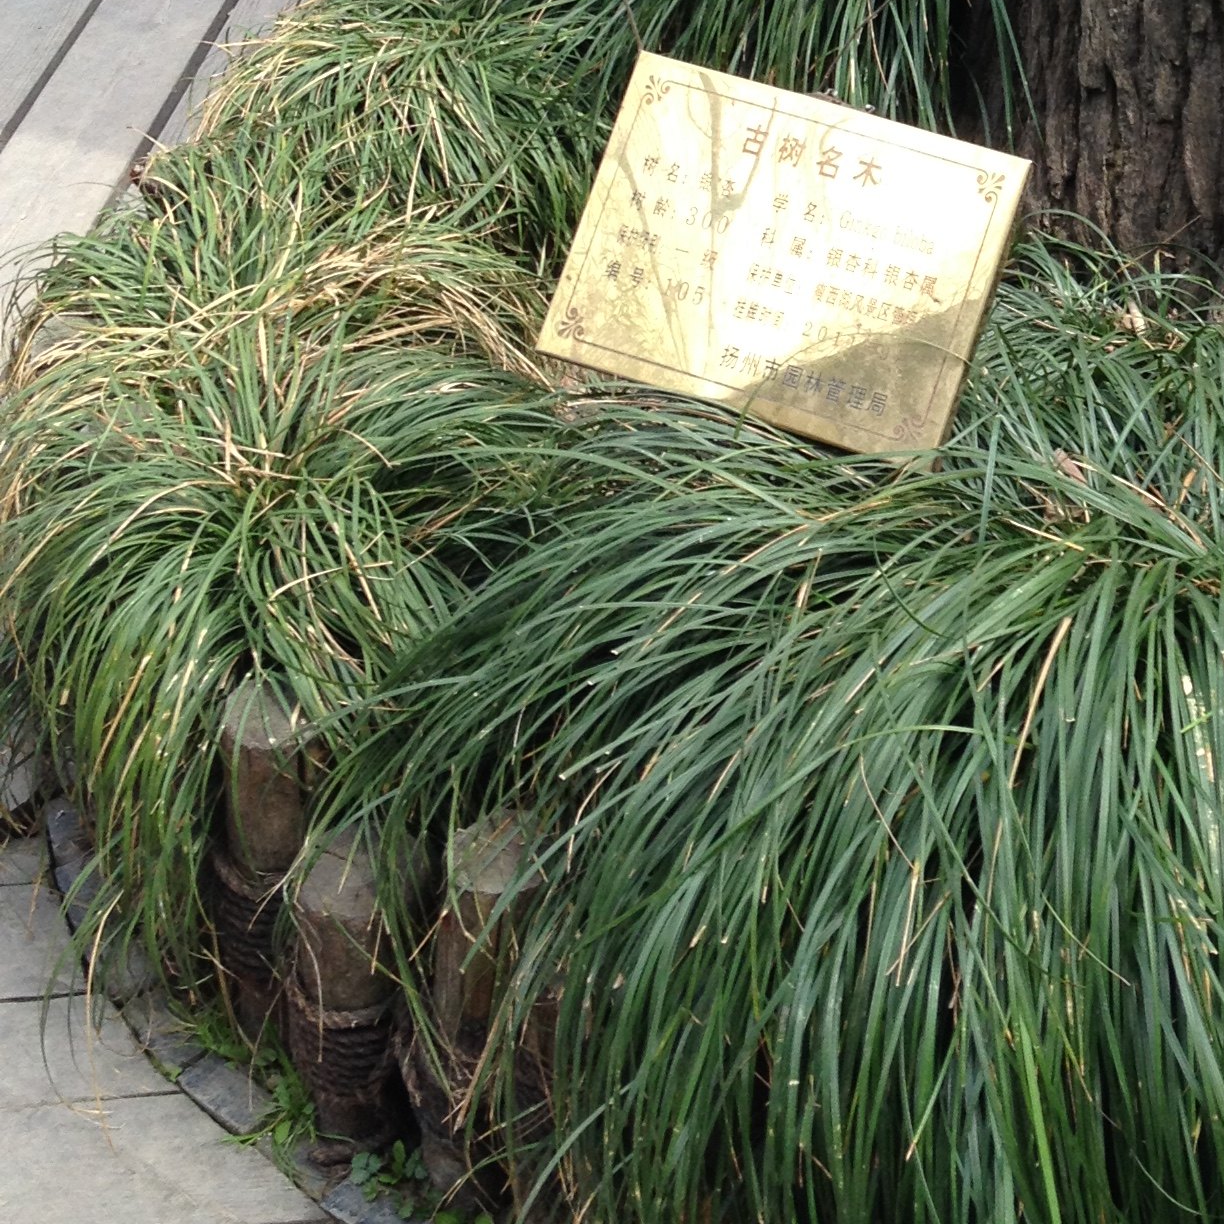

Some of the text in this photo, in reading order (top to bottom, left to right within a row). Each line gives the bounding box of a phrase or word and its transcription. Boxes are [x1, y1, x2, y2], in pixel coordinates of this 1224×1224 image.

[737, 120, 887, 191] 古树名木
[683, 205, 732, 236] 300
[661, 277, 707, 306] 105
[714, 343, 892, 417] 扬州市园林管理局
